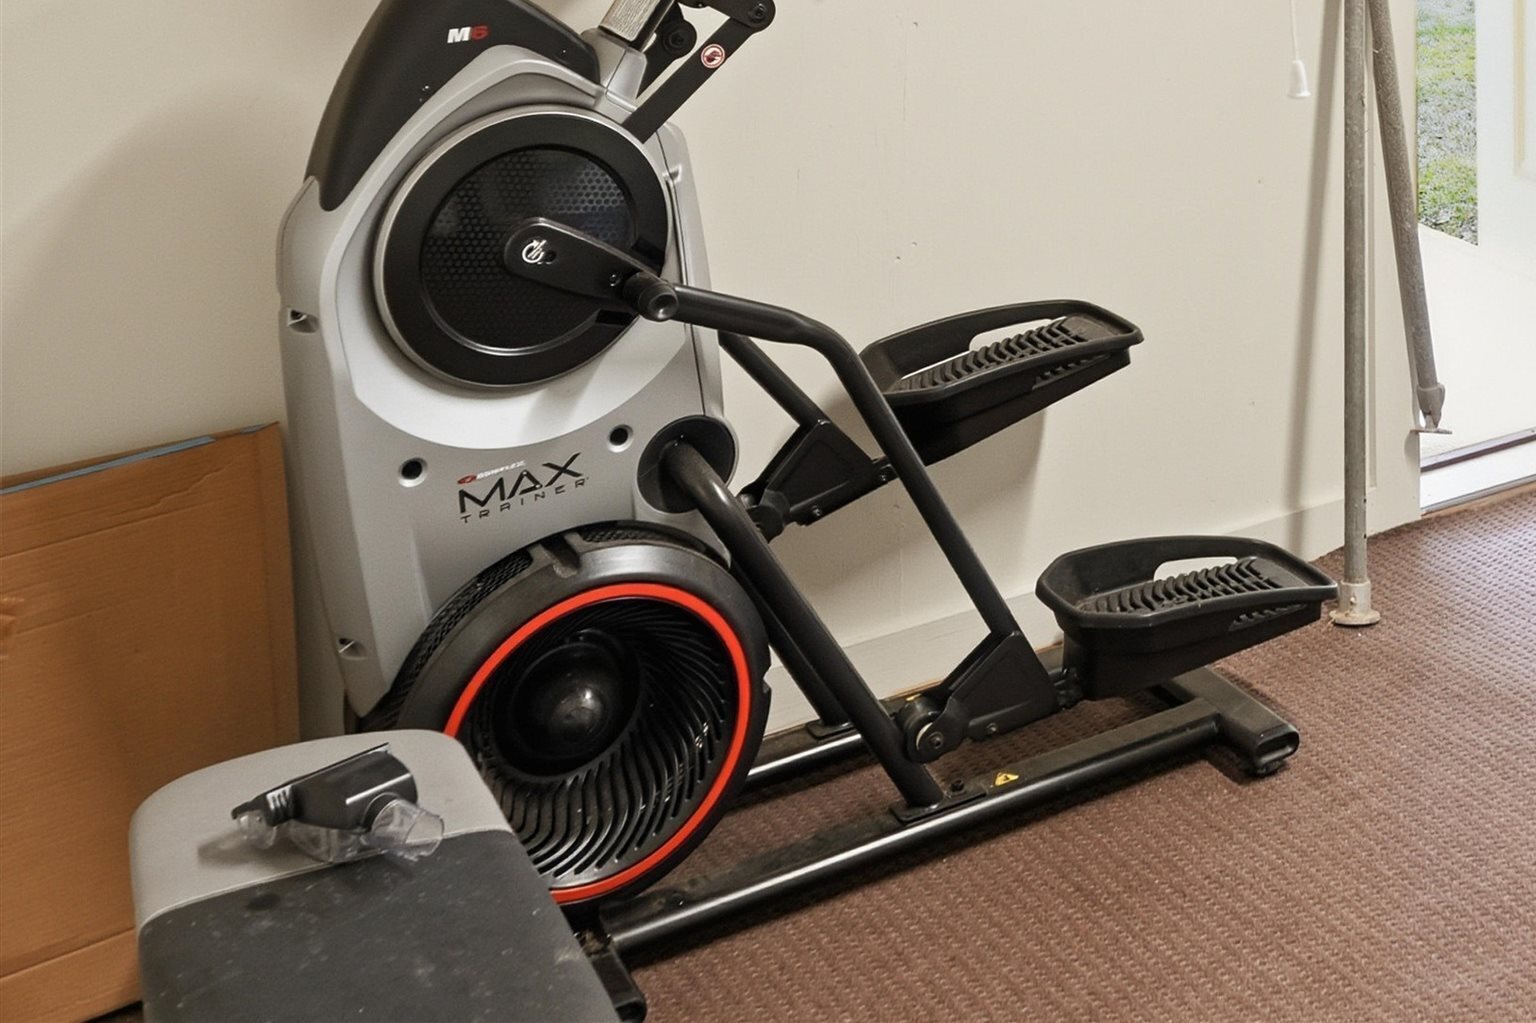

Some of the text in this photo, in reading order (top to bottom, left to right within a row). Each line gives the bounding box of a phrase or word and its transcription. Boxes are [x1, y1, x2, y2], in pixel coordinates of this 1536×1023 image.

[447, 26, 489, 43] M6
[458, 452, 584, 514] MAX
[460, 479, 586, 524] TRAINER
